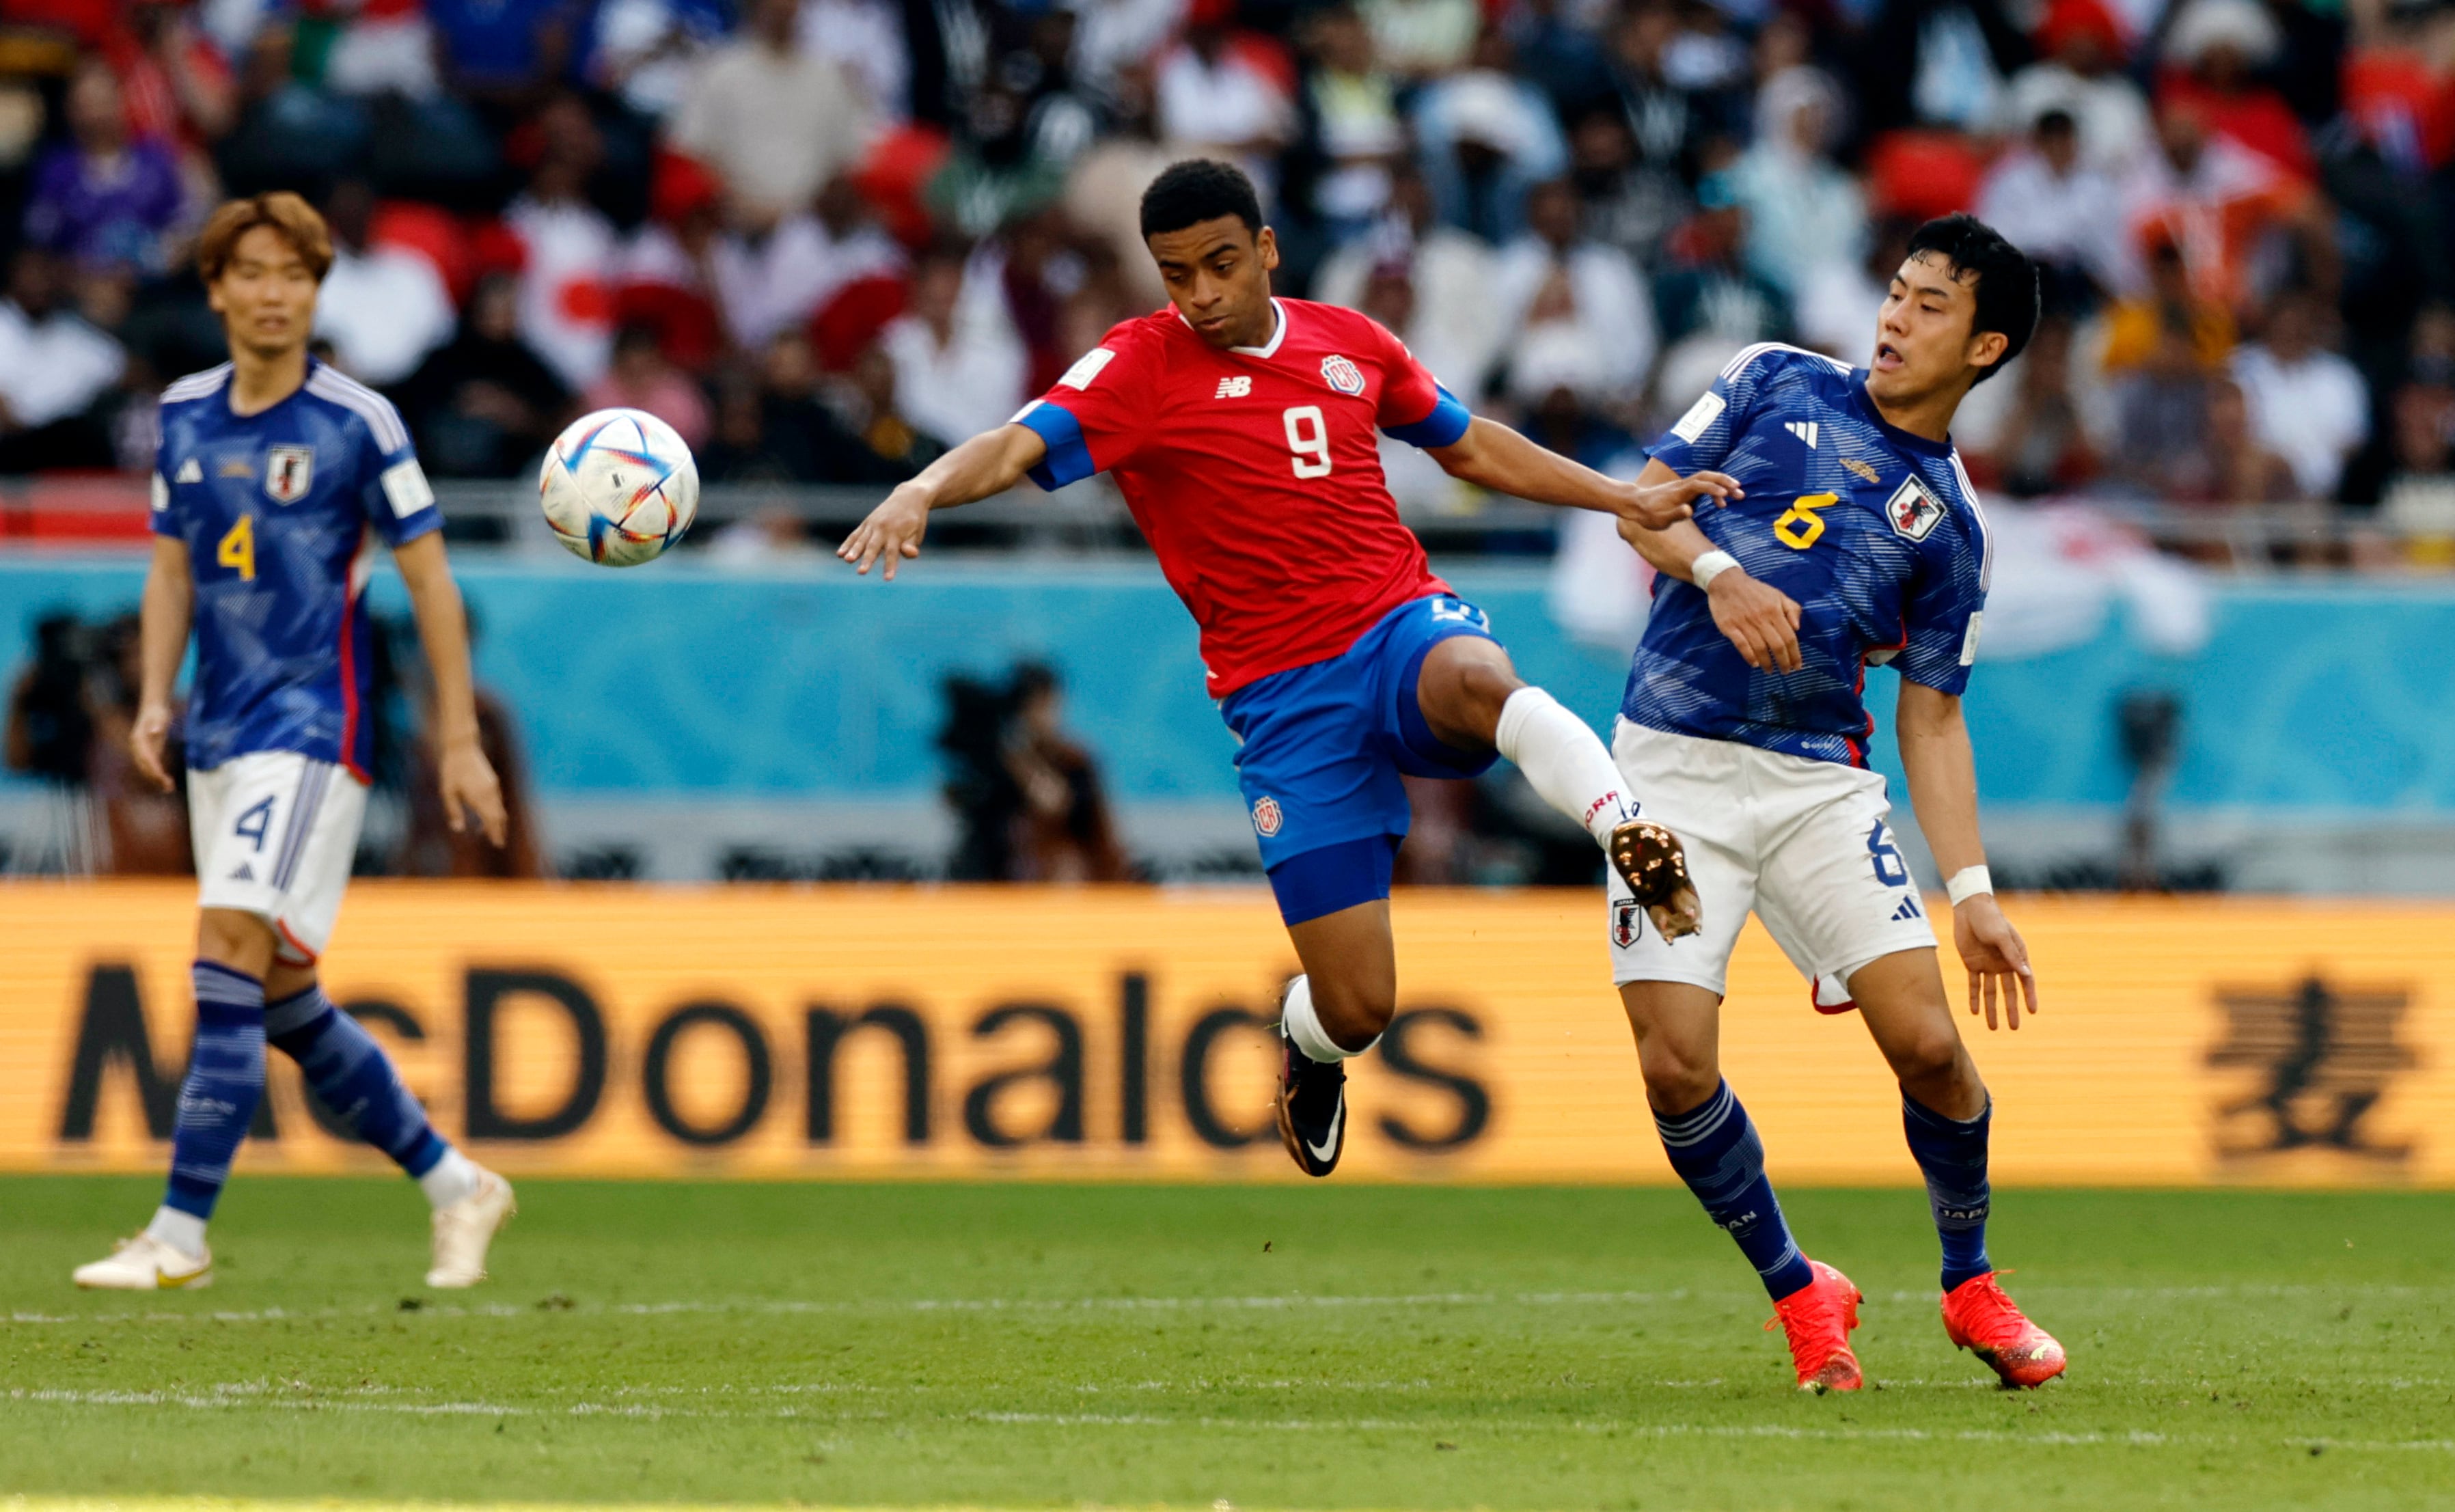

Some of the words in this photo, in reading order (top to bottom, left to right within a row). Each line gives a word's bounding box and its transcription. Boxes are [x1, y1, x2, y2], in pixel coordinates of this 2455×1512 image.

[1283, 405, 1332, 480] 9
[217, 514, 256, 581] 4
[1773, 491, 1839, 550] 6
[235, 795, 276, 853] 4
[1867, 819, 1908, 888] 6
